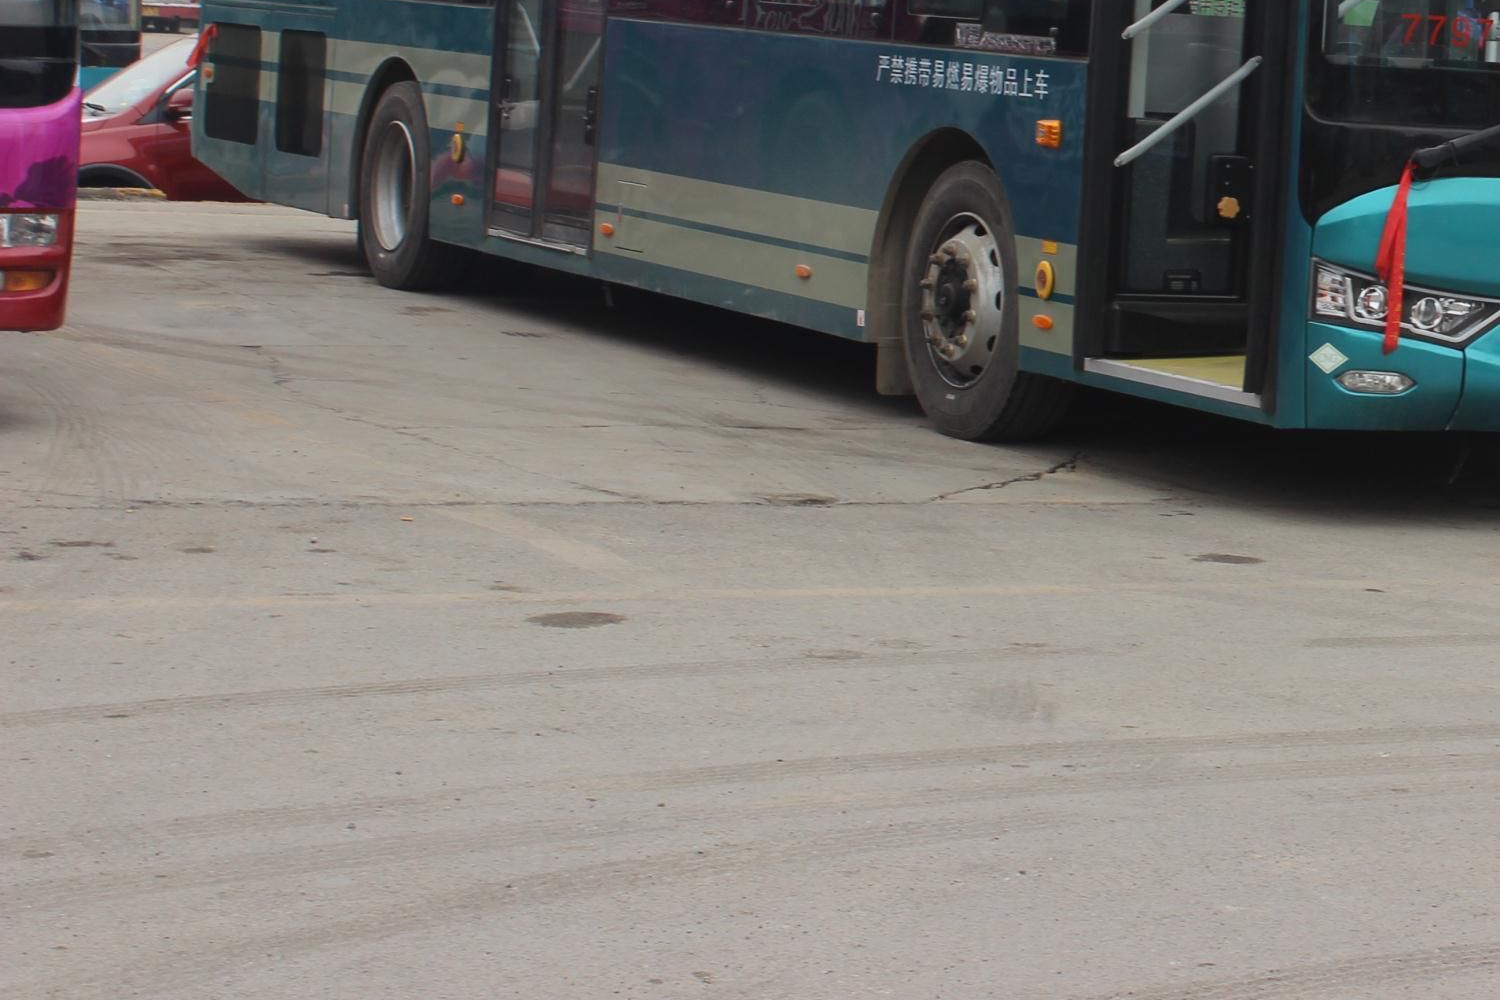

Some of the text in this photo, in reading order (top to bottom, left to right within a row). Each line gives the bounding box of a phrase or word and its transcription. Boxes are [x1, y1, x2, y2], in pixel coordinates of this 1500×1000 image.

[1400, 13, 1494, 48] 7797
[875, 55, 1050, 100] 严禁携带易燃易爆物品上车
